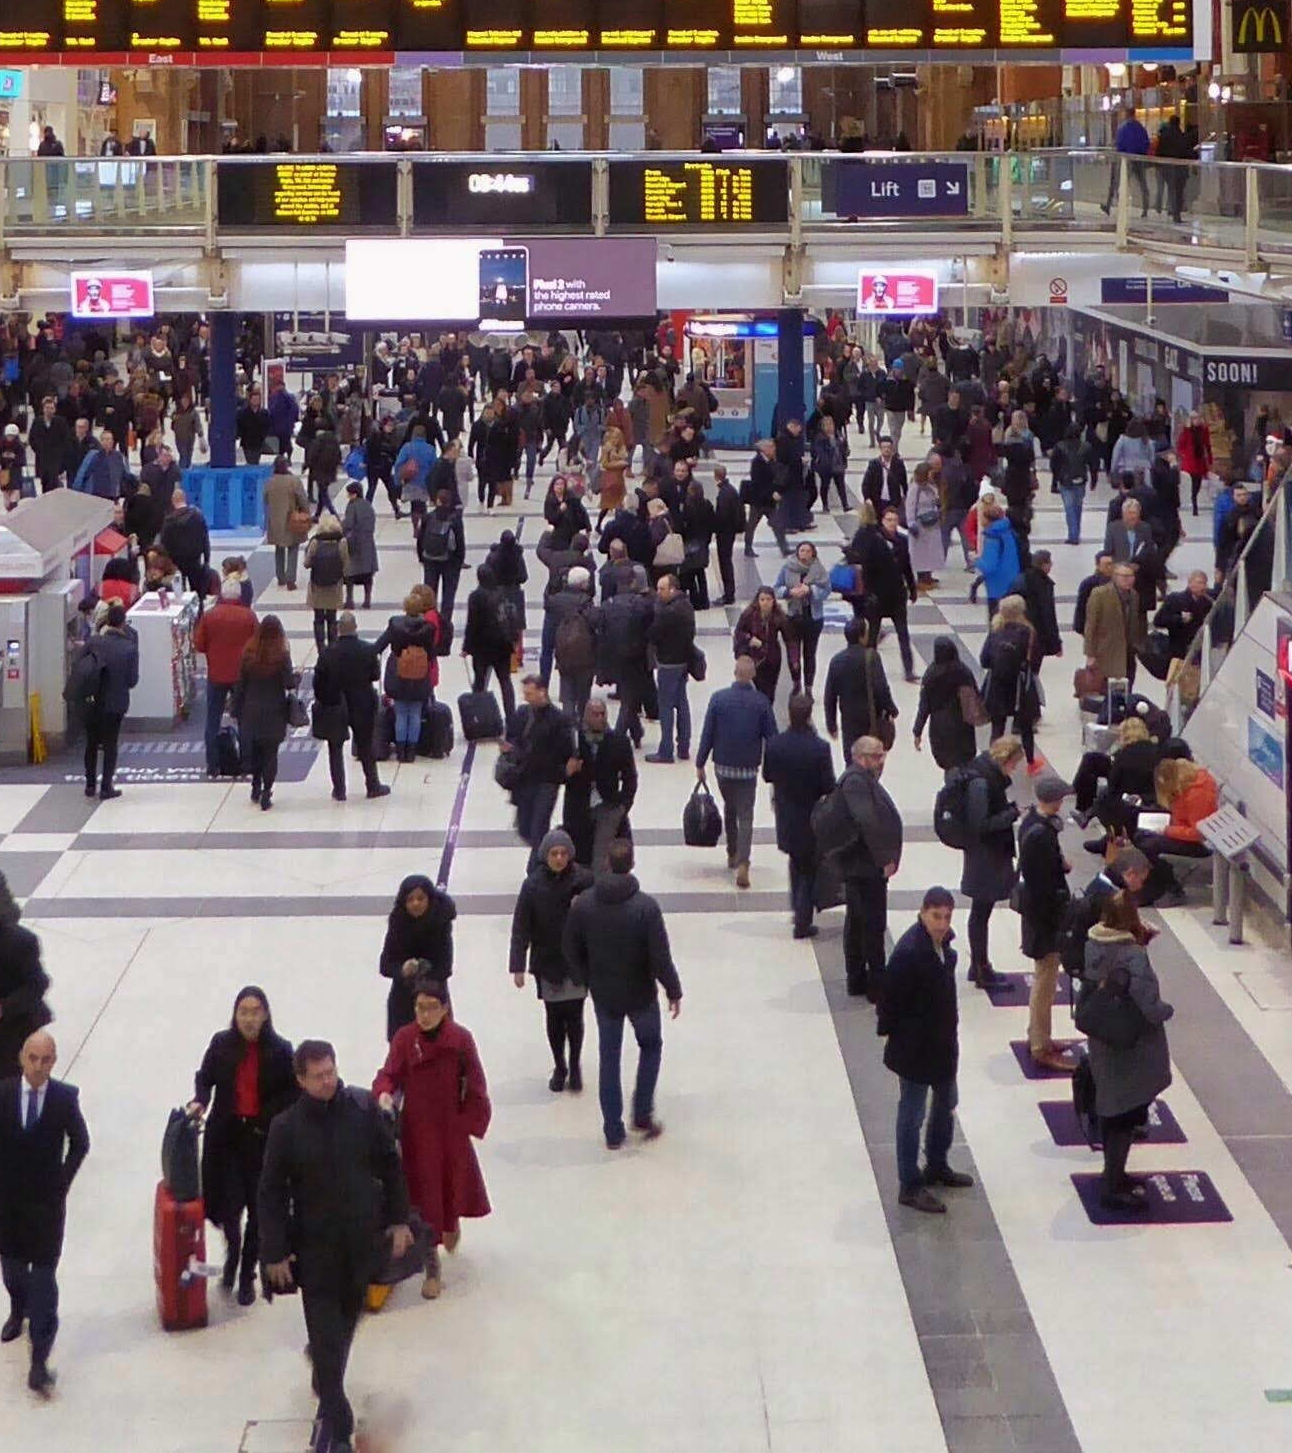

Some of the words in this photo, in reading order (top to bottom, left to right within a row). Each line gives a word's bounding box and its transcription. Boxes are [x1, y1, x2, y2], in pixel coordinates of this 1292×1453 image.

[148, 54, 173, 64] East
[817, 51, 843, 61] West
[871, 181, 899, 197] Lift
[566, 280, 585, 288] with
[534, 291, 549, 299] the
[550, 291, 584, 301] highest
[585, 291, 610, 299] rated
[534, 302, 563, 312] phone
[1207, 362, 1258, 383] SOON!
[168, 766, 206, 775] you
